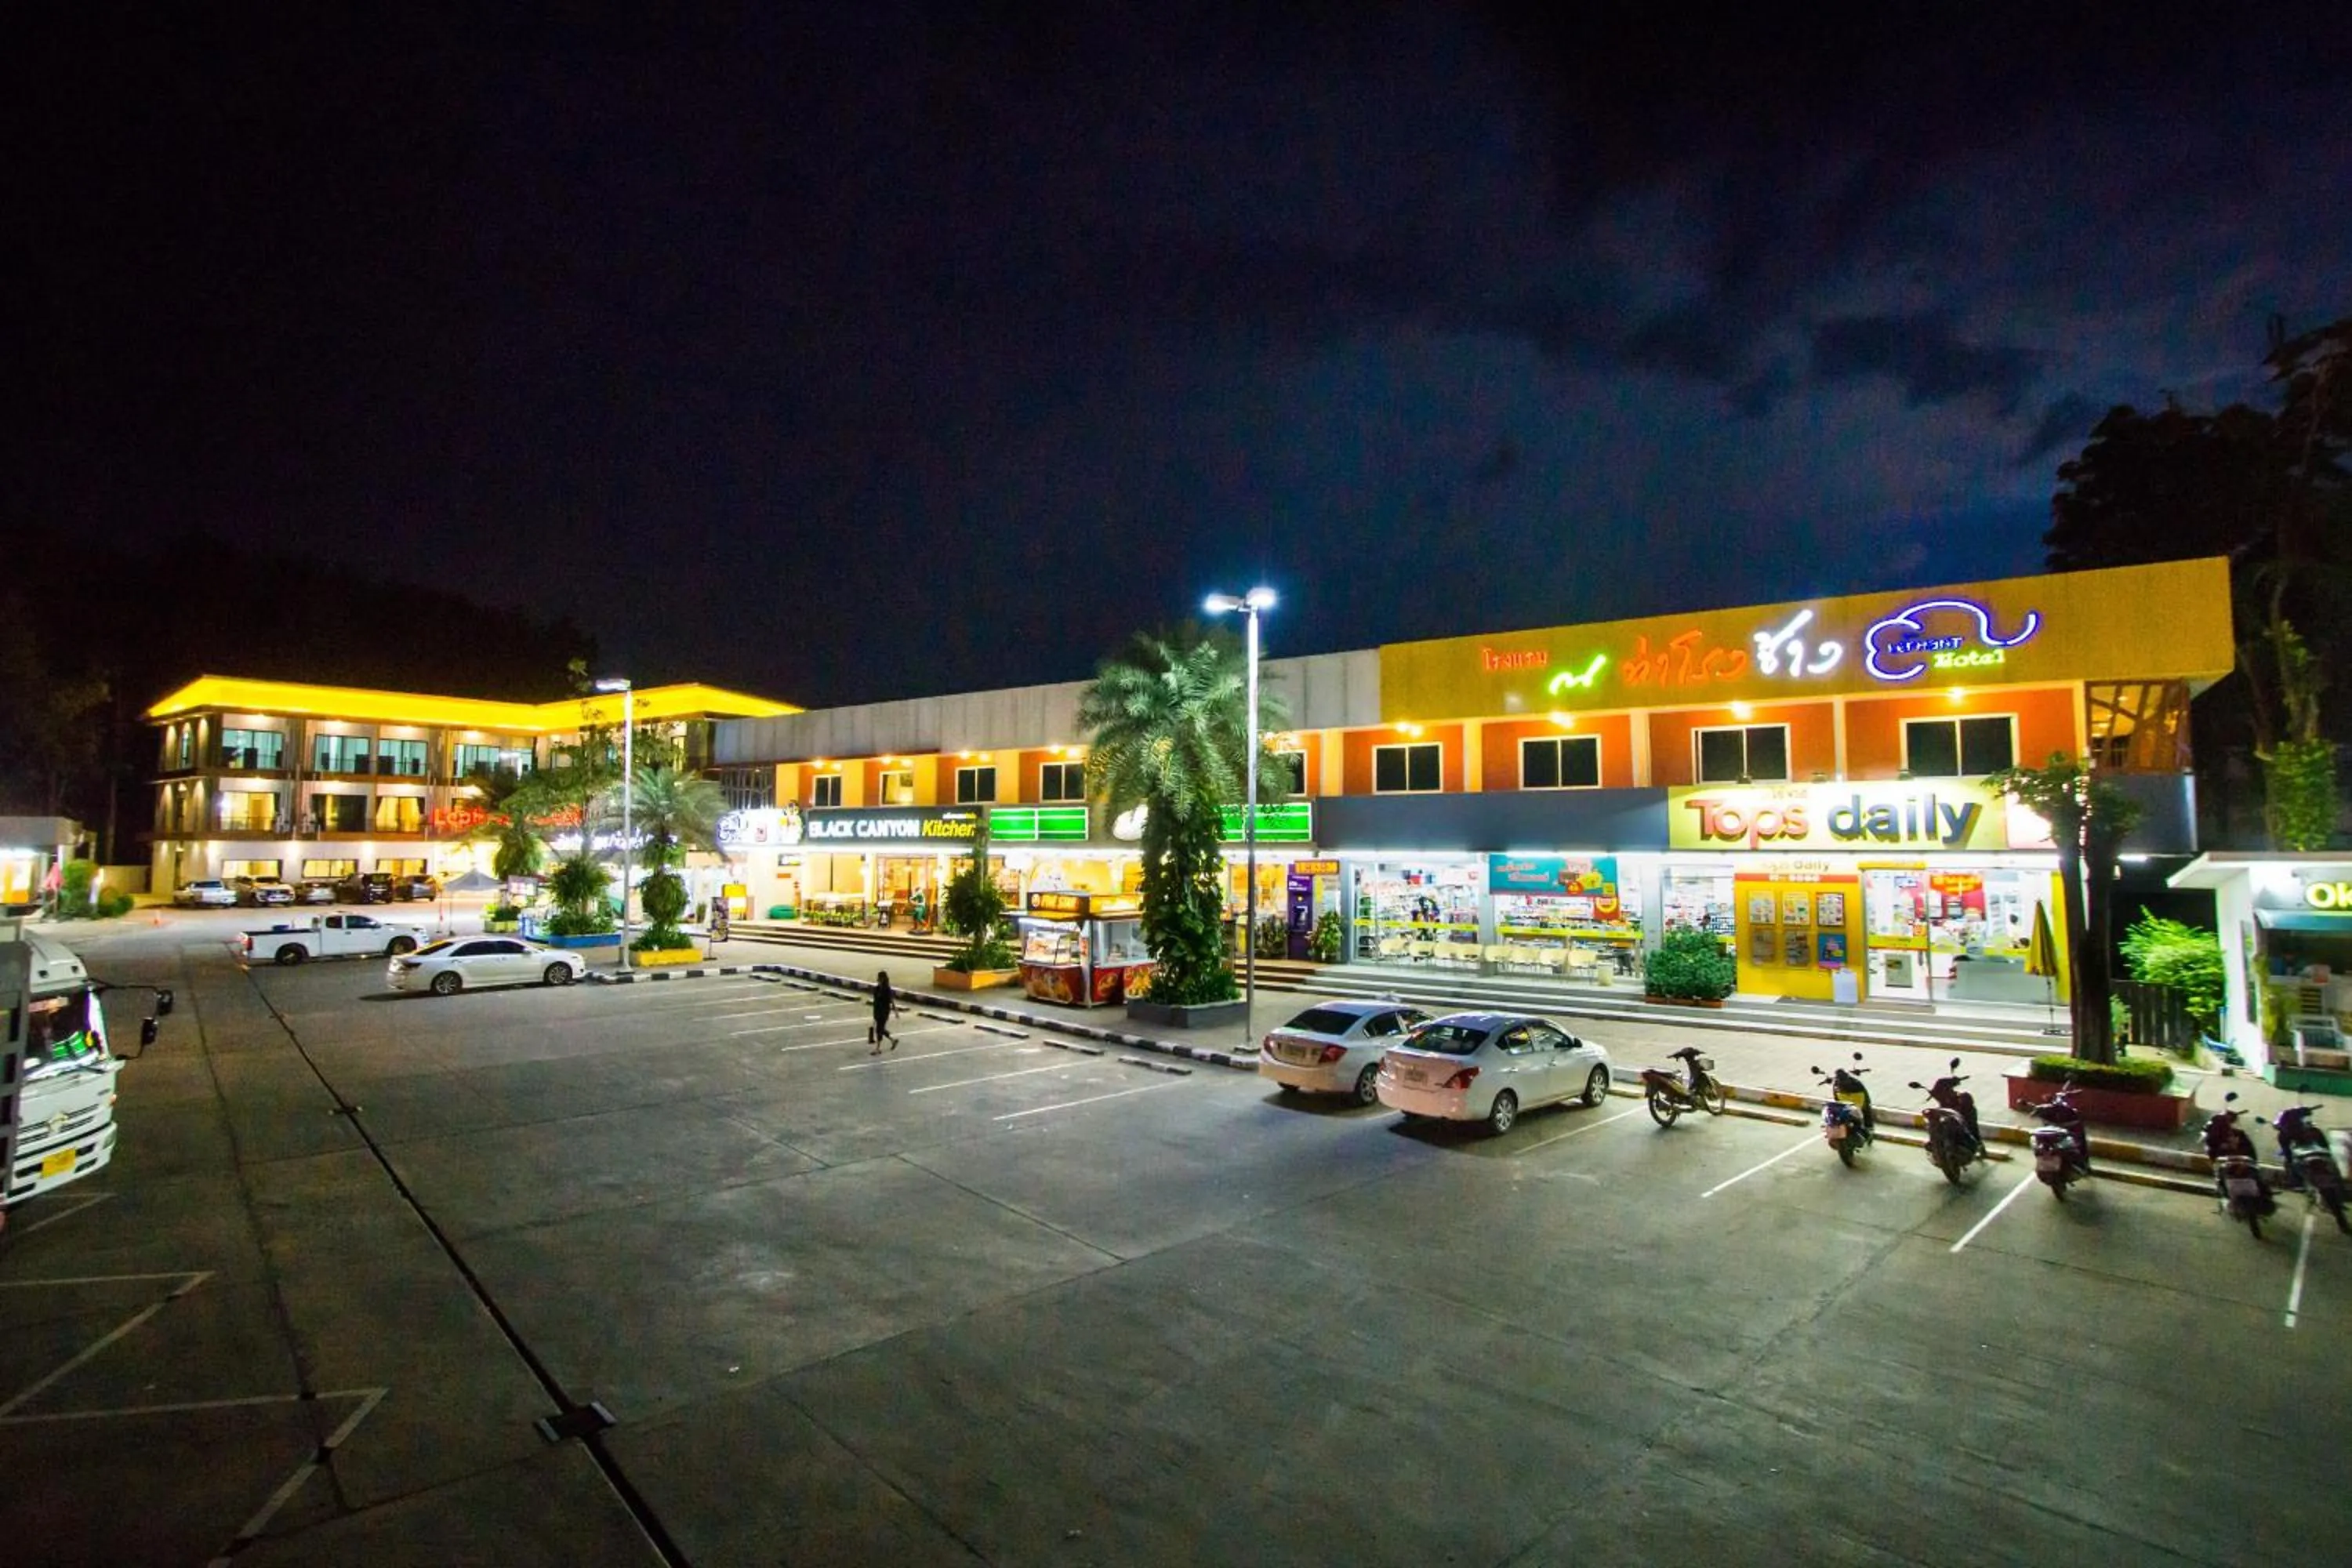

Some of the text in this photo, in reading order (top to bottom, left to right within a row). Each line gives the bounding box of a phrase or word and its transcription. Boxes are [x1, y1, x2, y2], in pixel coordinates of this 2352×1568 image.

[808, 821, 854, 838] BLACK
[856, 819, 920, 837] CANYON
[1685, 793, 1984, 850] Tops daily
